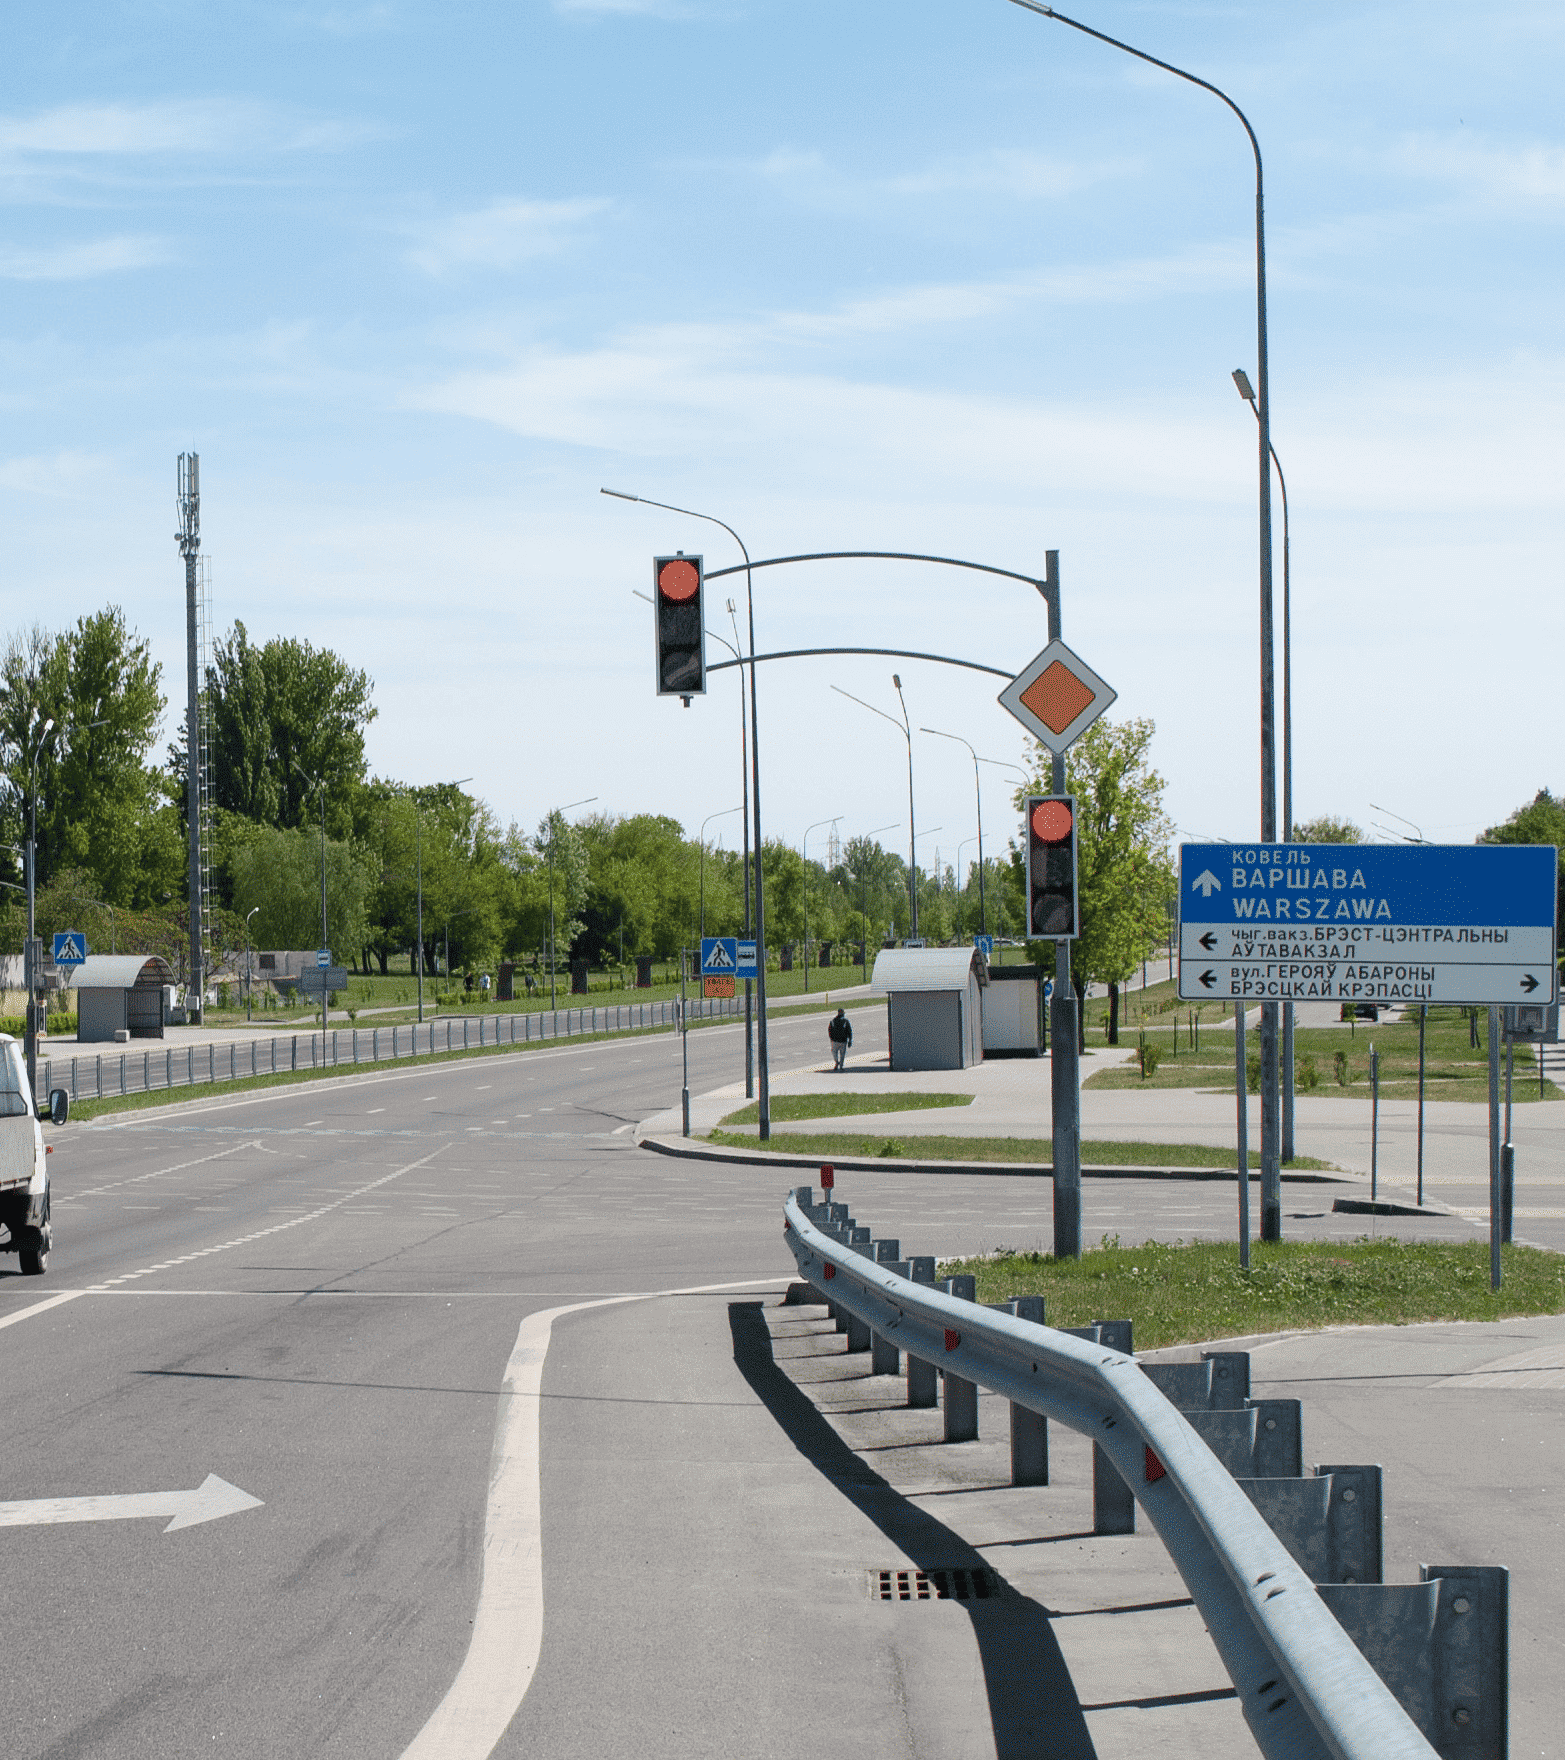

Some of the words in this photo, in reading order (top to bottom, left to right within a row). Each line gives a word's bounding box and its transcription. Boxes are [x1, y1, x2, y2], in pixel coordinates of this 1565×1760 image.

[1232, 850, 1311, 865] КОВЕЛЬ
[1232, 868, 1367, 889] ВАРШАВА
[1232, 898, 1393, 919] WARSZAWA
[1231, 939, 1356, 958] АЎТАВАКЗАЛ
[1345, 965, 1435, 981] АБАРОНЫ
[1231, 979, 1332, 998] БРЭСЦКАЙ
[1339, 982, 1432, 1000] КРЭПАСЦІ
